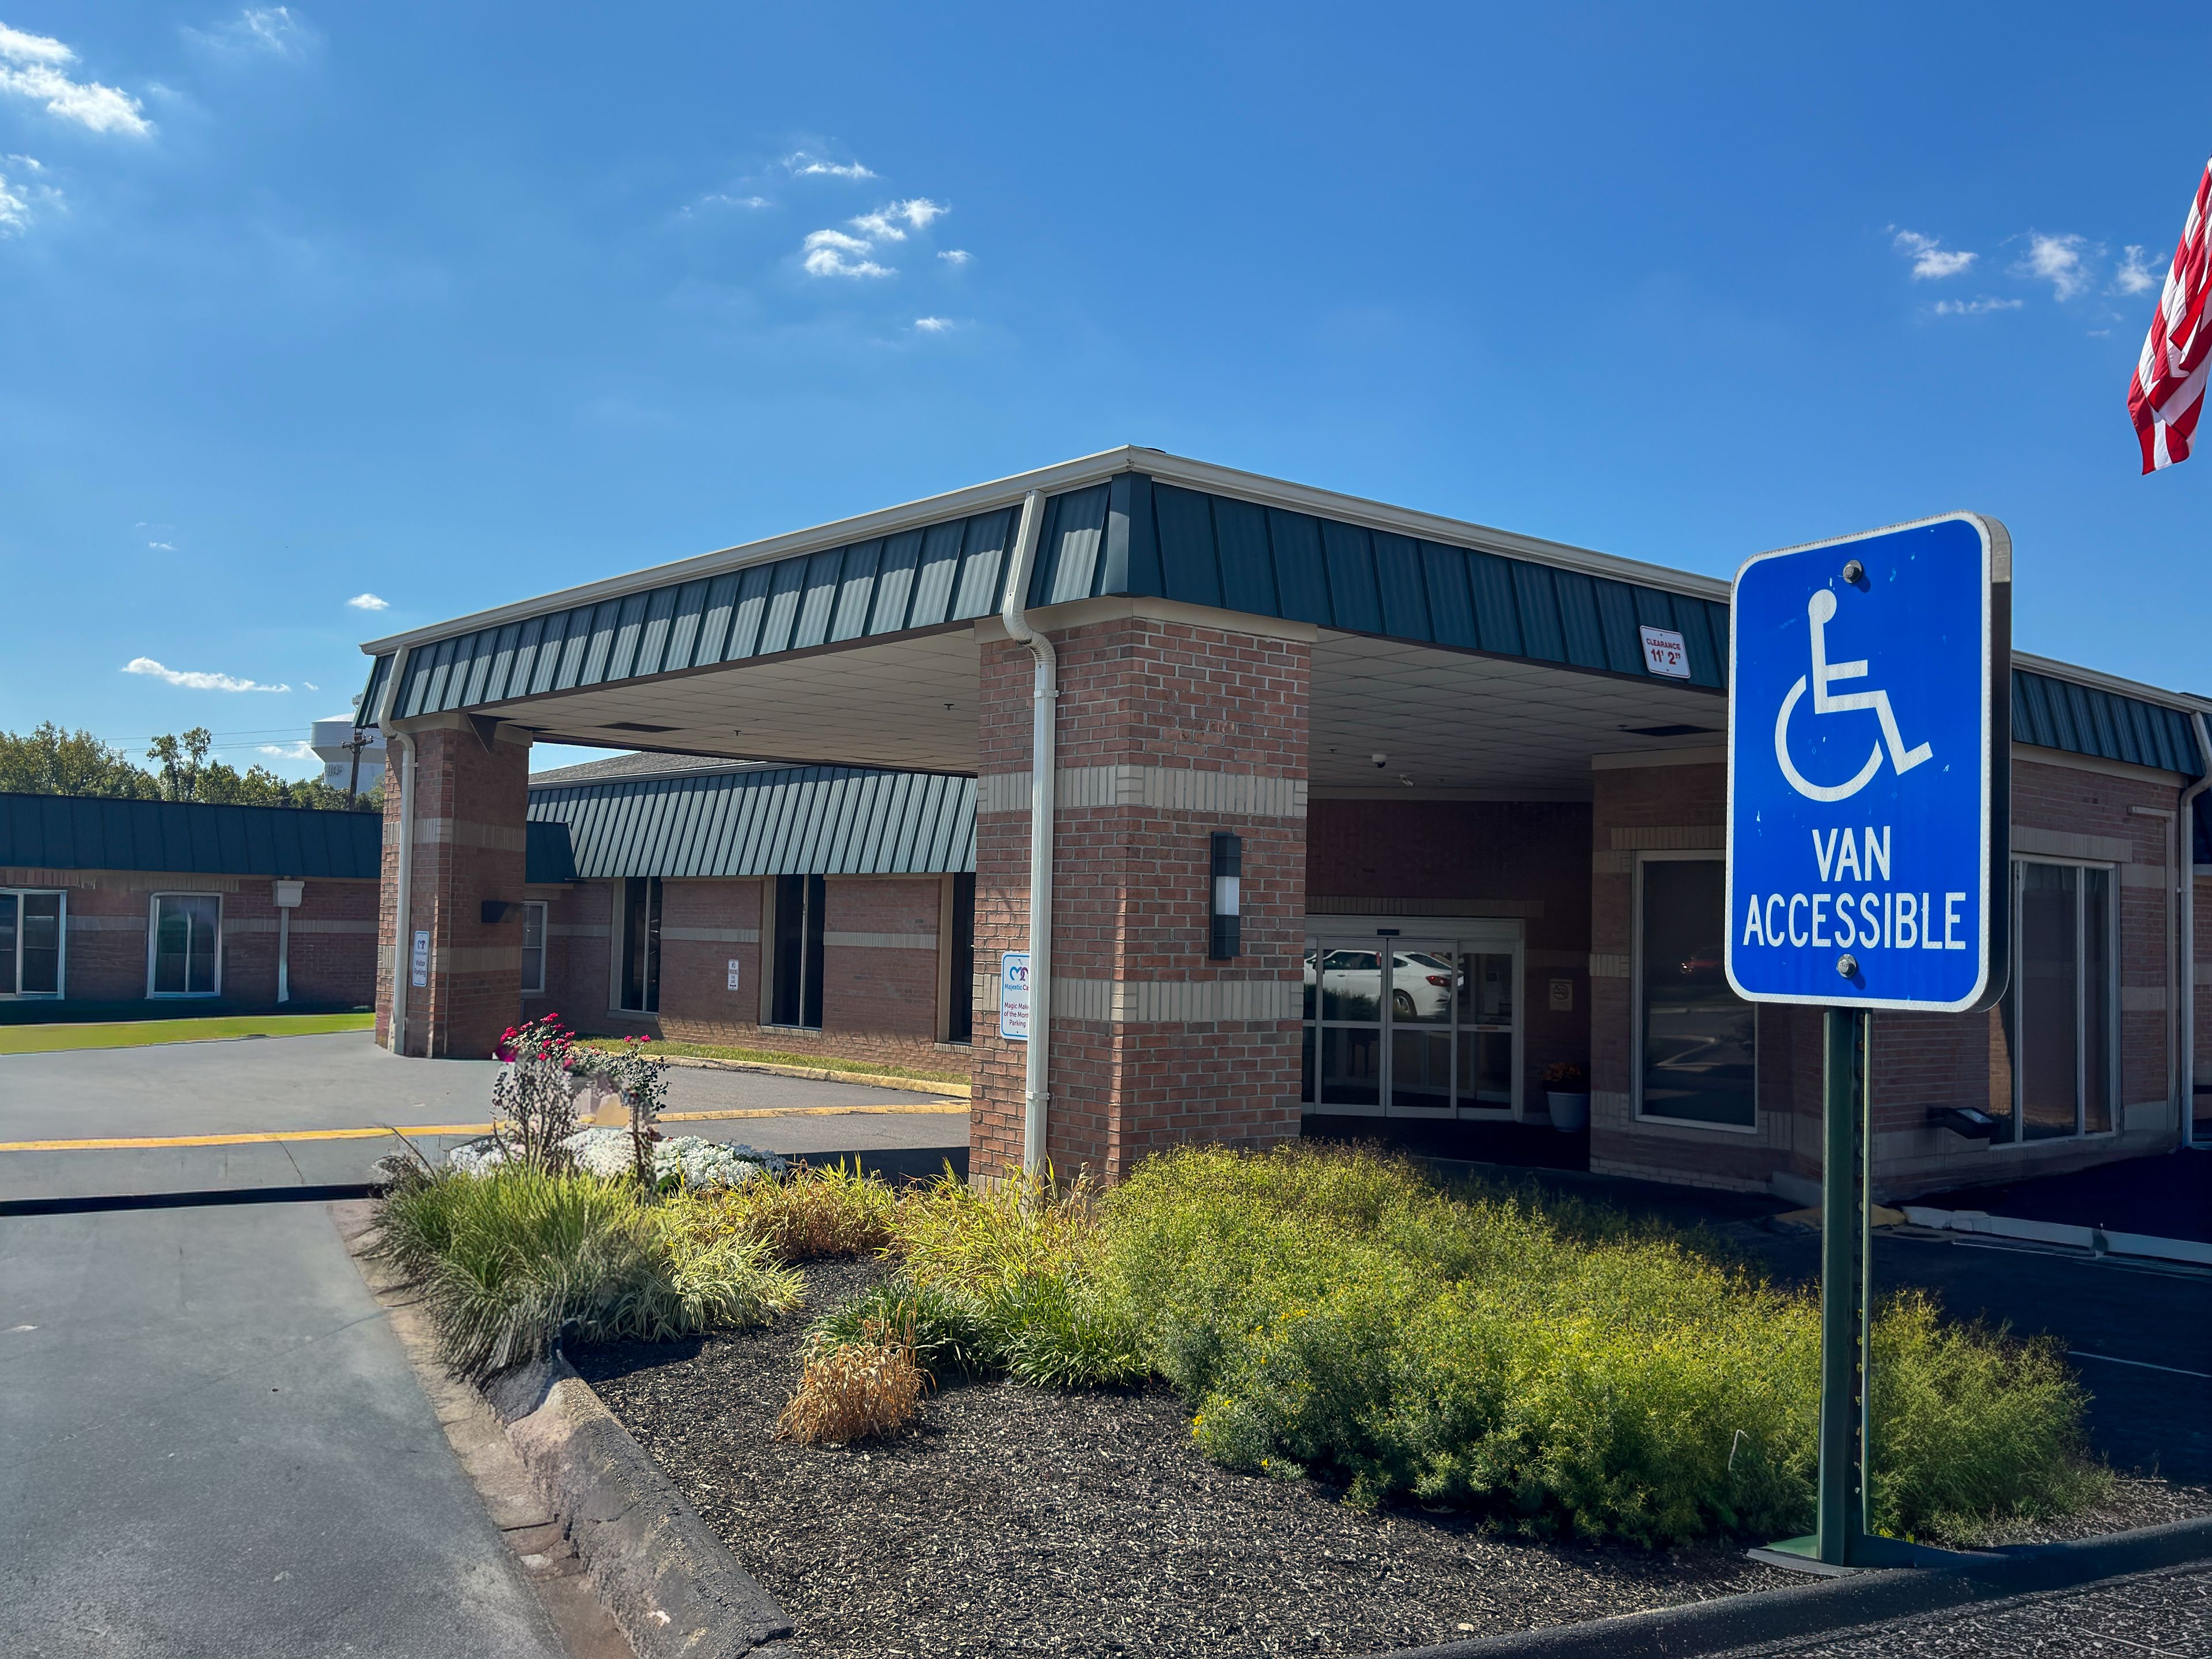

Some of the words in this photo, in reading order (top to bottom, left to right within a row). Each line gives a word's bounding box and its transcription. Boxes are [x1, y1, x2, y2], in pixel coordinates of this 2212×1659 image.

[1646, 638, 1681, 650] CLEARANCE
[1651, 649, 1664, 662] 11'
[1812, 825, 1891, 882] VAN
[1743, 892, 1967, 950] ACCESSIBLE
[1004, 1002, 1018, 1010] Magic
[1009, 1020, 1026, 1028] Parking
